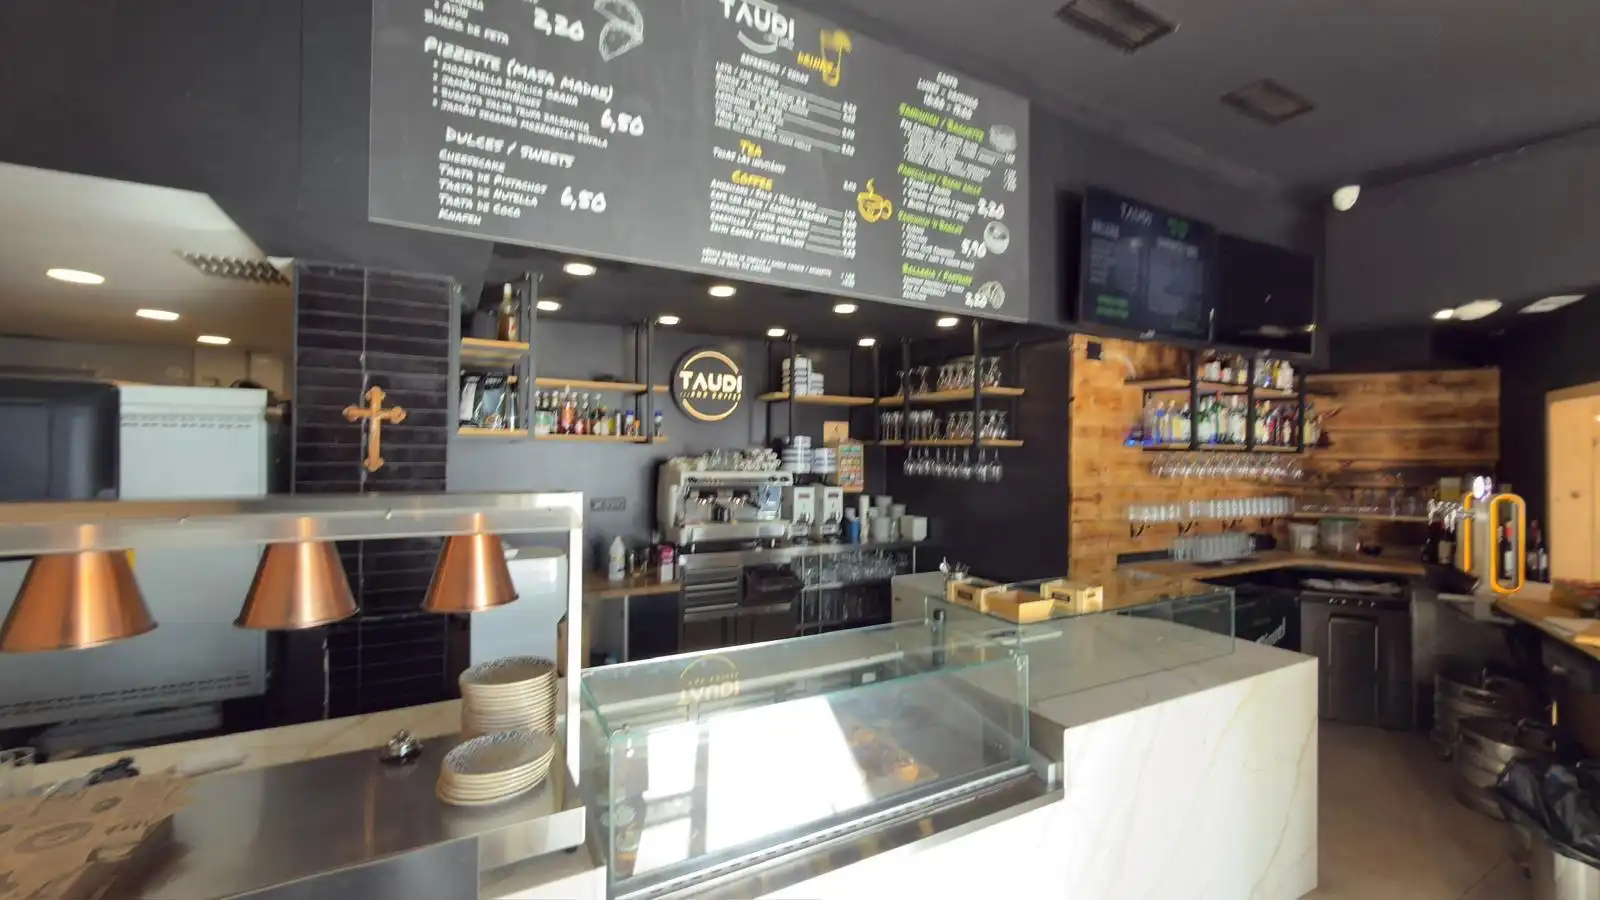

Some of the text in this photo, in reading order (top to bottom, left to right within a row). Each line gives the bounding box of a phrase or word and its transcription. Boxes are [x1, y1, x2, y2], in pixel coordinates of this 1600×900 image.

[534, 6, 584, 42] 2,20
[719, 0, 795, 42] TAUDI
[600, 108, 644, 137] 6,50
[445, 126, 575, 169] DULCES / SWEETS
[439, 163, 474, 181] TARTA
[439, 178, 474, 195] TARTA
[561, 185, 607, 213] 6,50
[439, 192, 473, 210] TARTA
[679, 370, 742, 393] TAUDI
